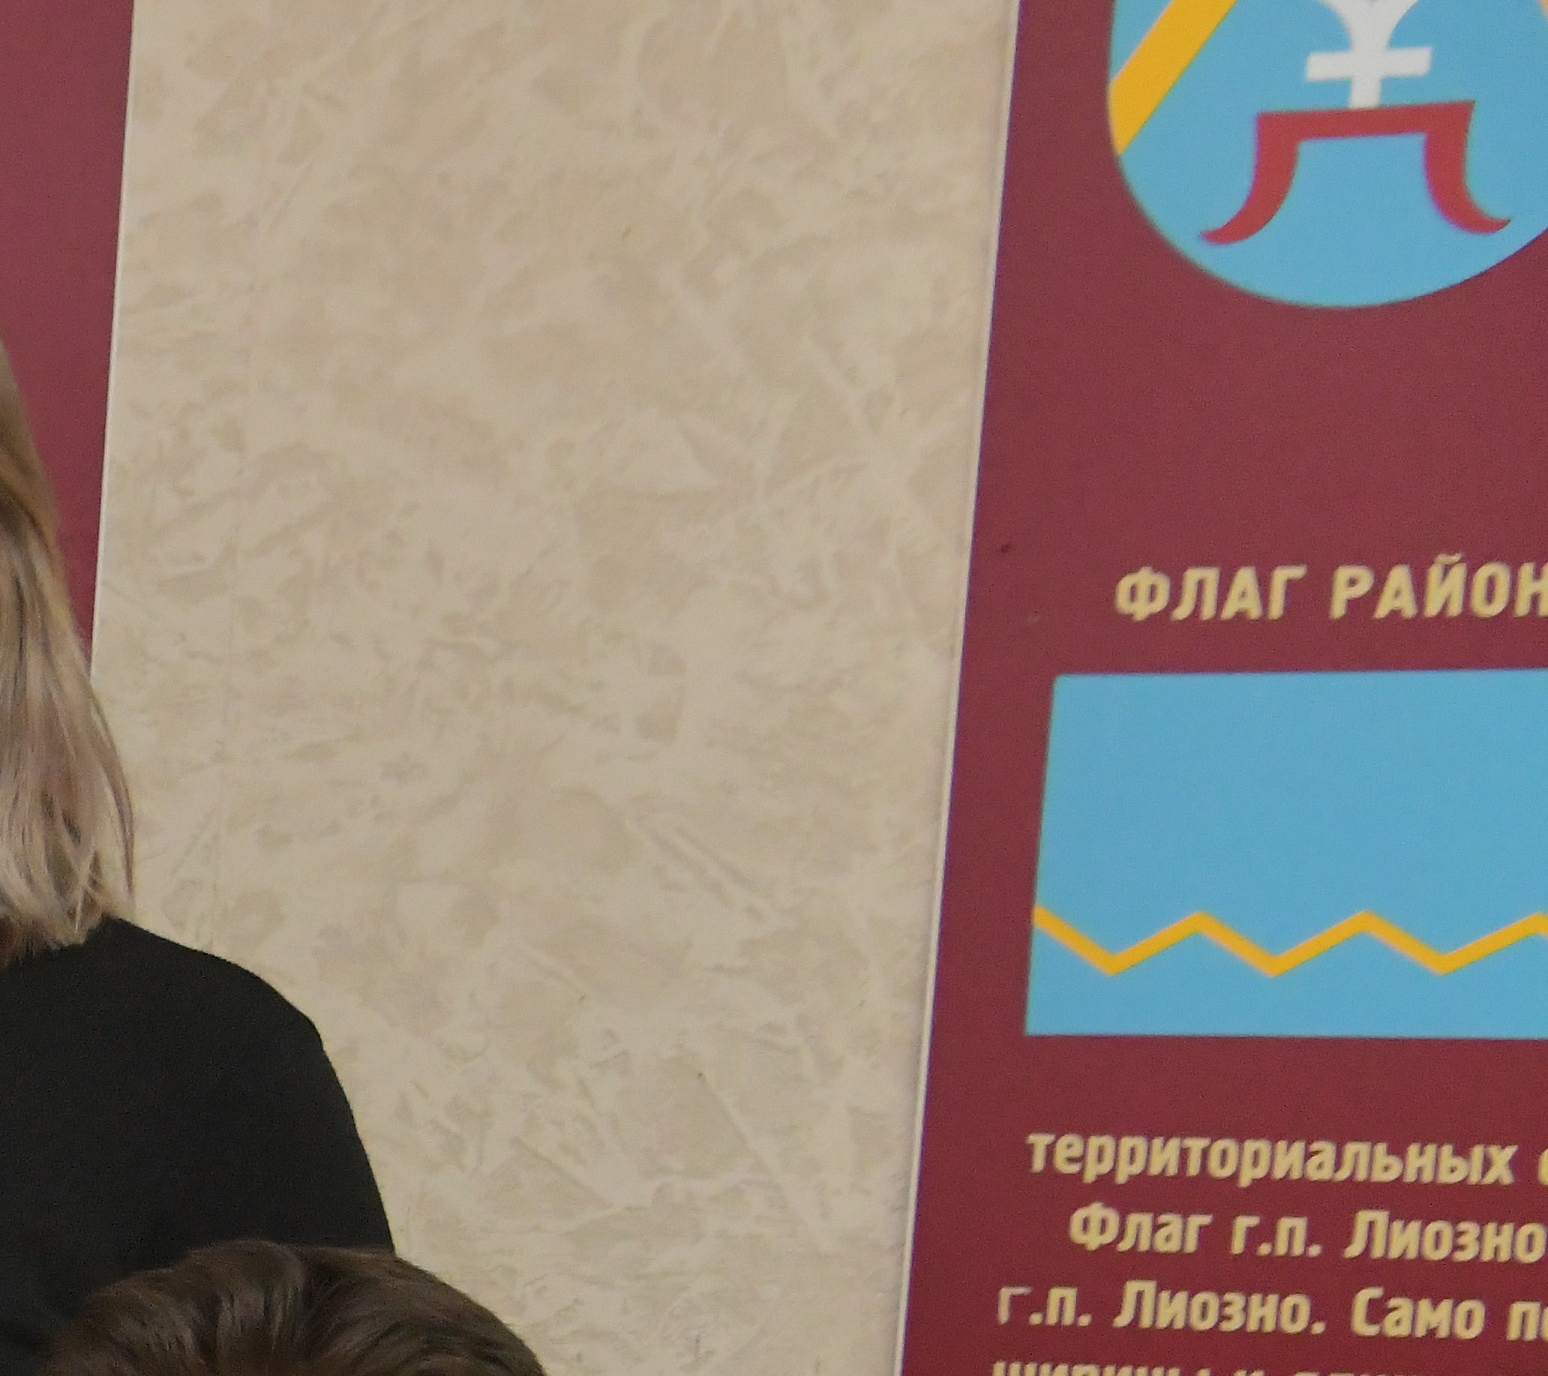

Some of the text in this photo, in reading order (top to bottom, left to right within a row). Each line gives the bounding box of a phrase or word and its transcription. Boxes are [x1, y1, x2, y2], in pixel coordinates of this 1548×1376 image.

[1115, 553, 1548, 621] ФЛАГ РАЙОН
[1026, 1133, 1518, 1188] территориальных
[1069, 1201, 1547, 1264] Флаг г.п. Лиозно
[998, 1279, 1486, 1340] г.п. Лиозно. Само
